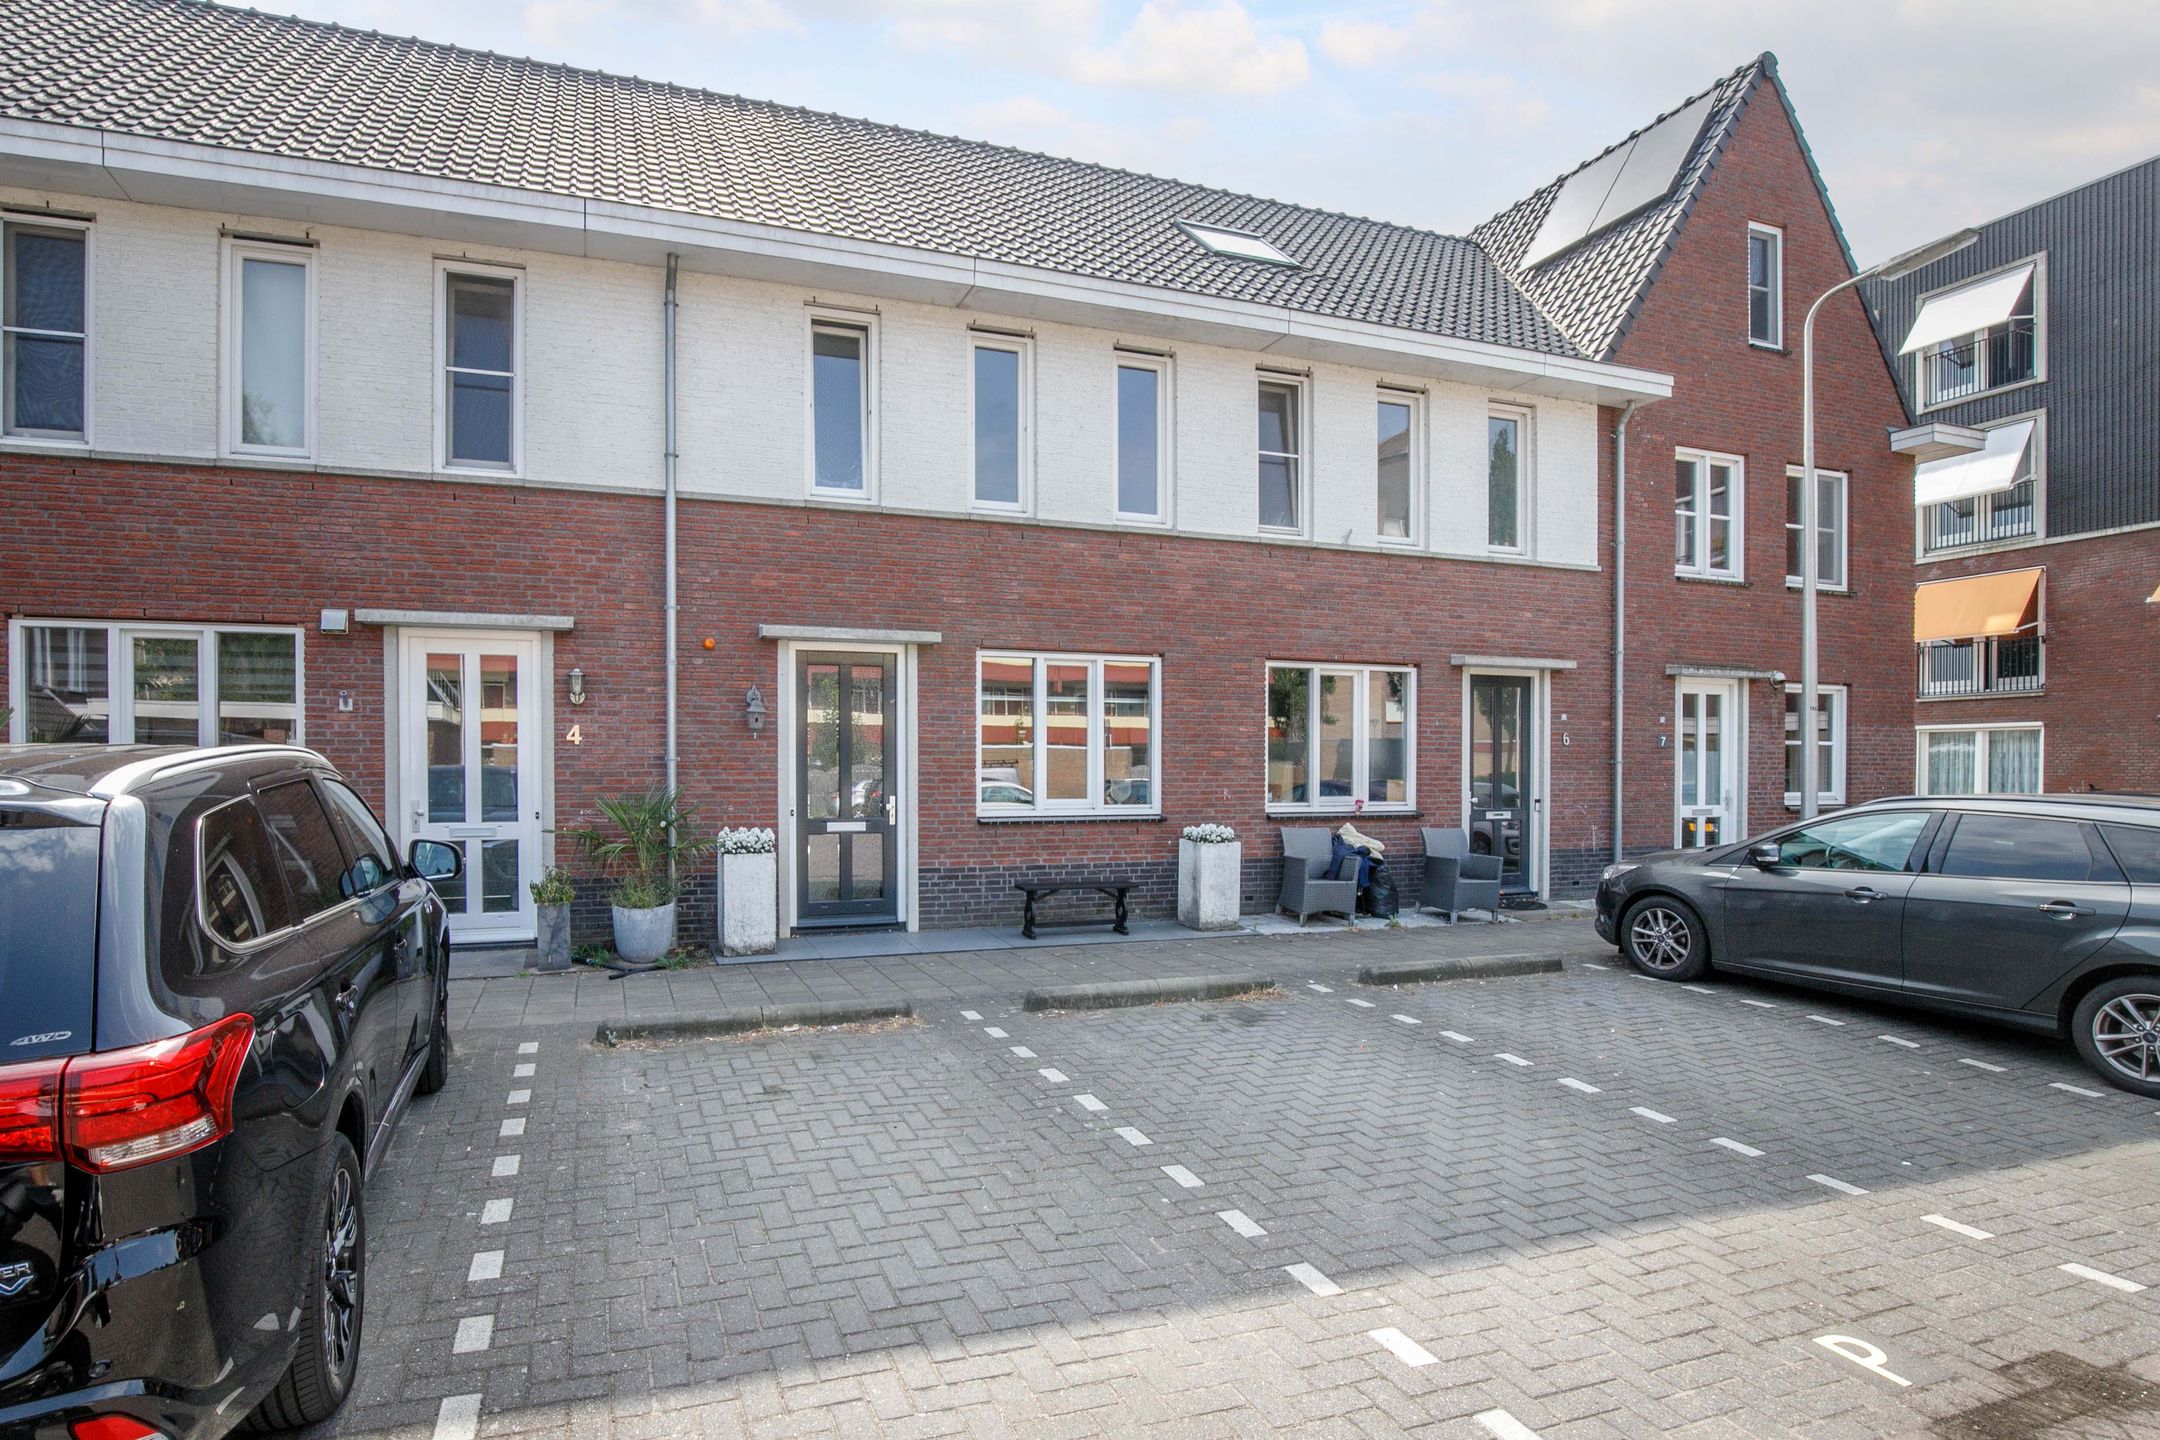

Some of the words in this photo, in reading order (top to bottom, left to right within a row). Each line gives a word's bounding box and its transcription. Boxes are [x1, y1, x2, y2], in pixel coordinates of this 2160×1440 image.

[566, 724, 583, 745] 4
[1563, 732, 1570, 746] 6
[9, 1030, 72, 1046] 4WD
[1811, 1334, 1914, 1387] P
